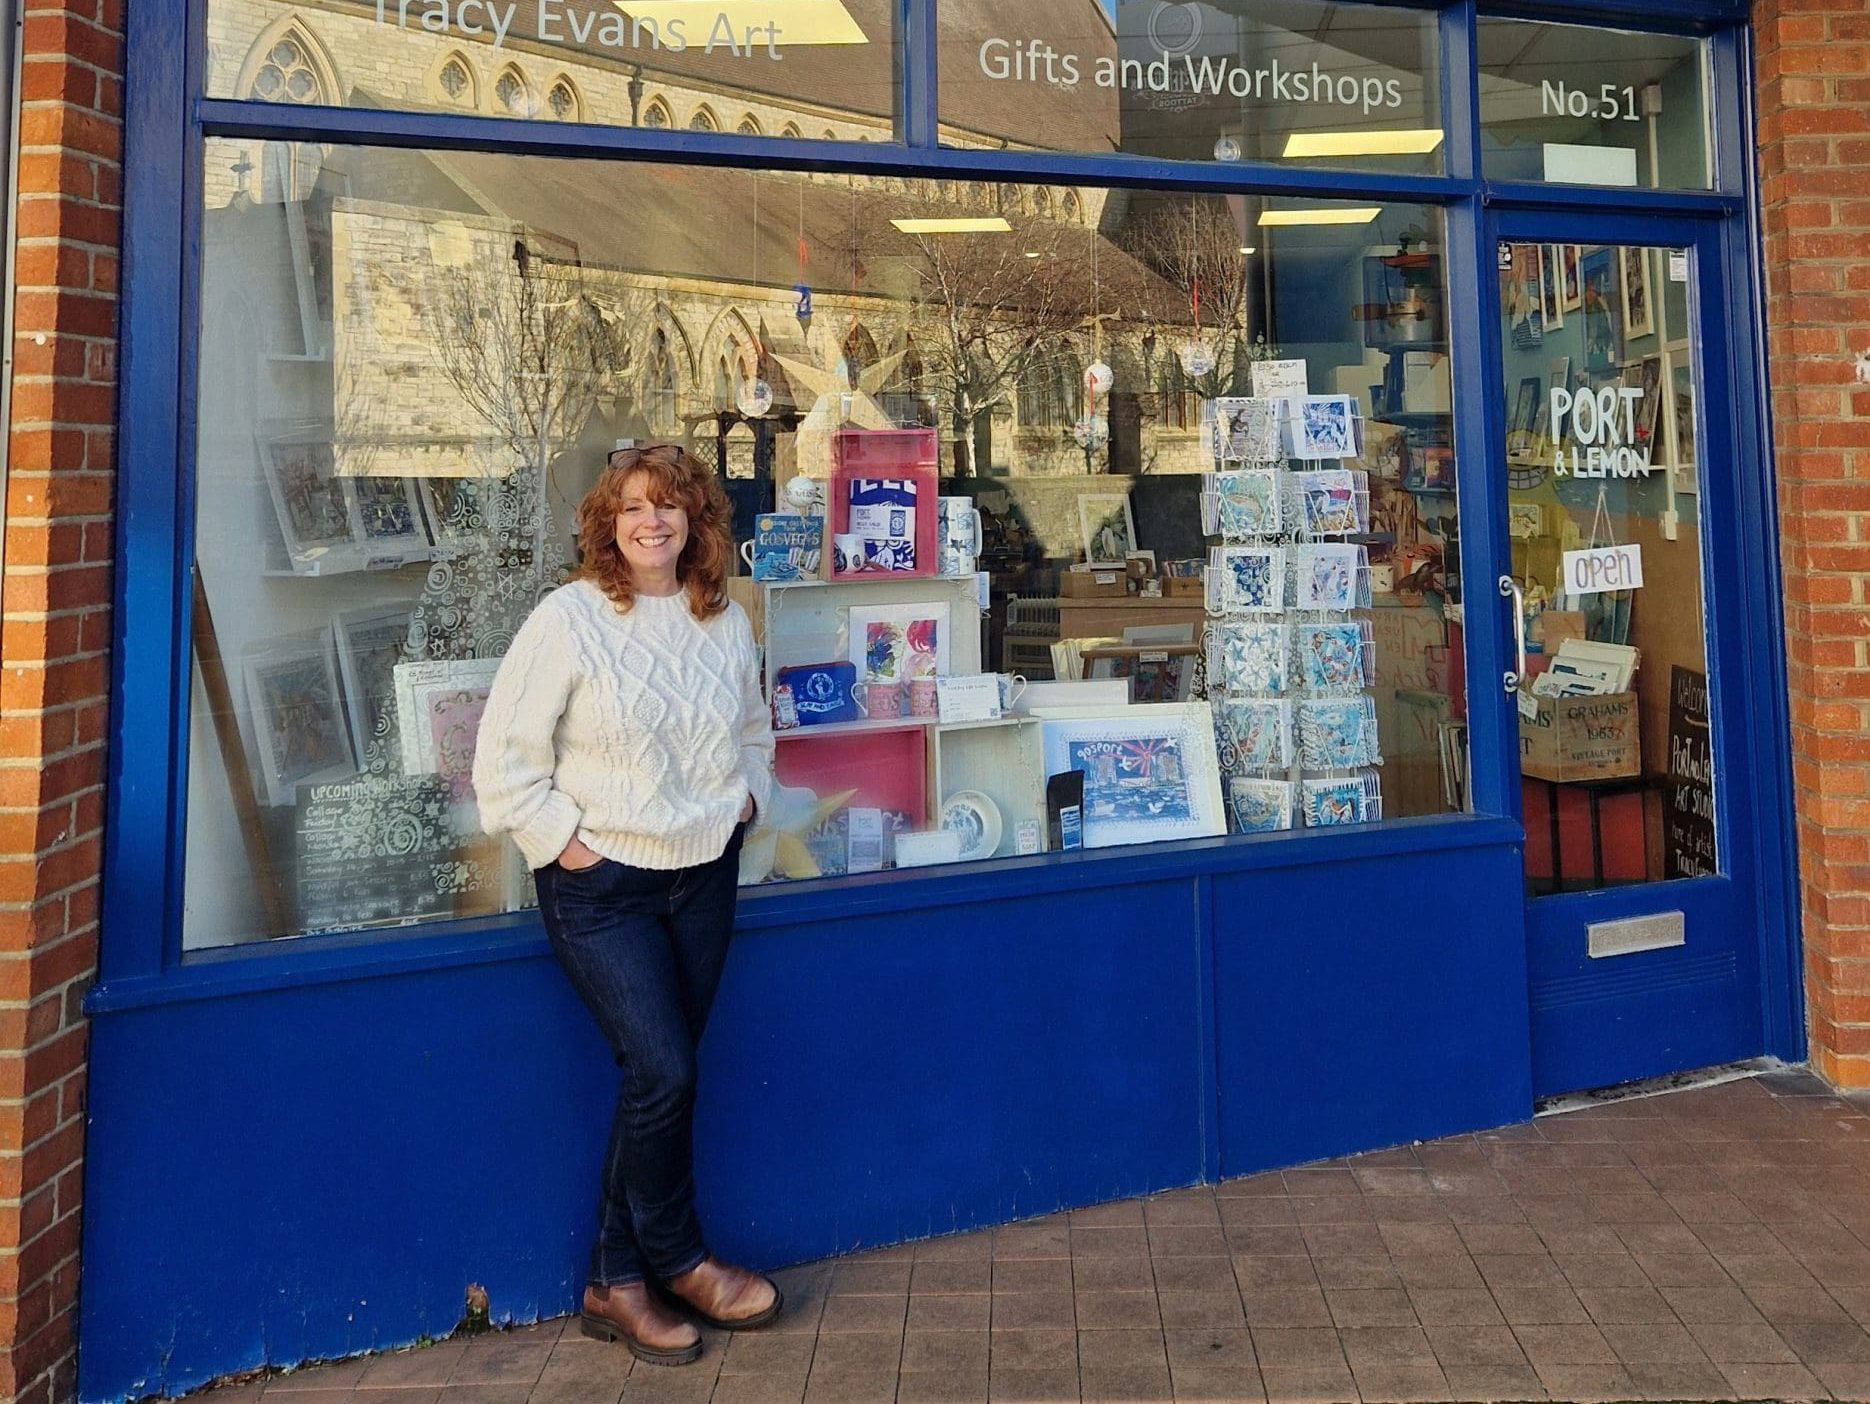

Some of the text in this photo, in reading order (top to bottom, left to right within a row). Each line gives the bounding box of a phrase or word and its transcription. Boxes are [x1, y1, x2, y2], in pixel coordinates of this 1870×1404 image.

[538, 0, 686, 53] Evans
[704, 12, 783, 61] Art
[979, 37, 1081, 86] Gifts
[1094, 50, 1170, 93] and
[1184, 54, 1403, 116] Workshops
[1541, 79, 1640, 121] No.51
[1549, 386, 1645, 445] PORT
[1553, 446, 1650, 479] & LEMON
[1567, 702, 1629, 720] GRAHAMS
